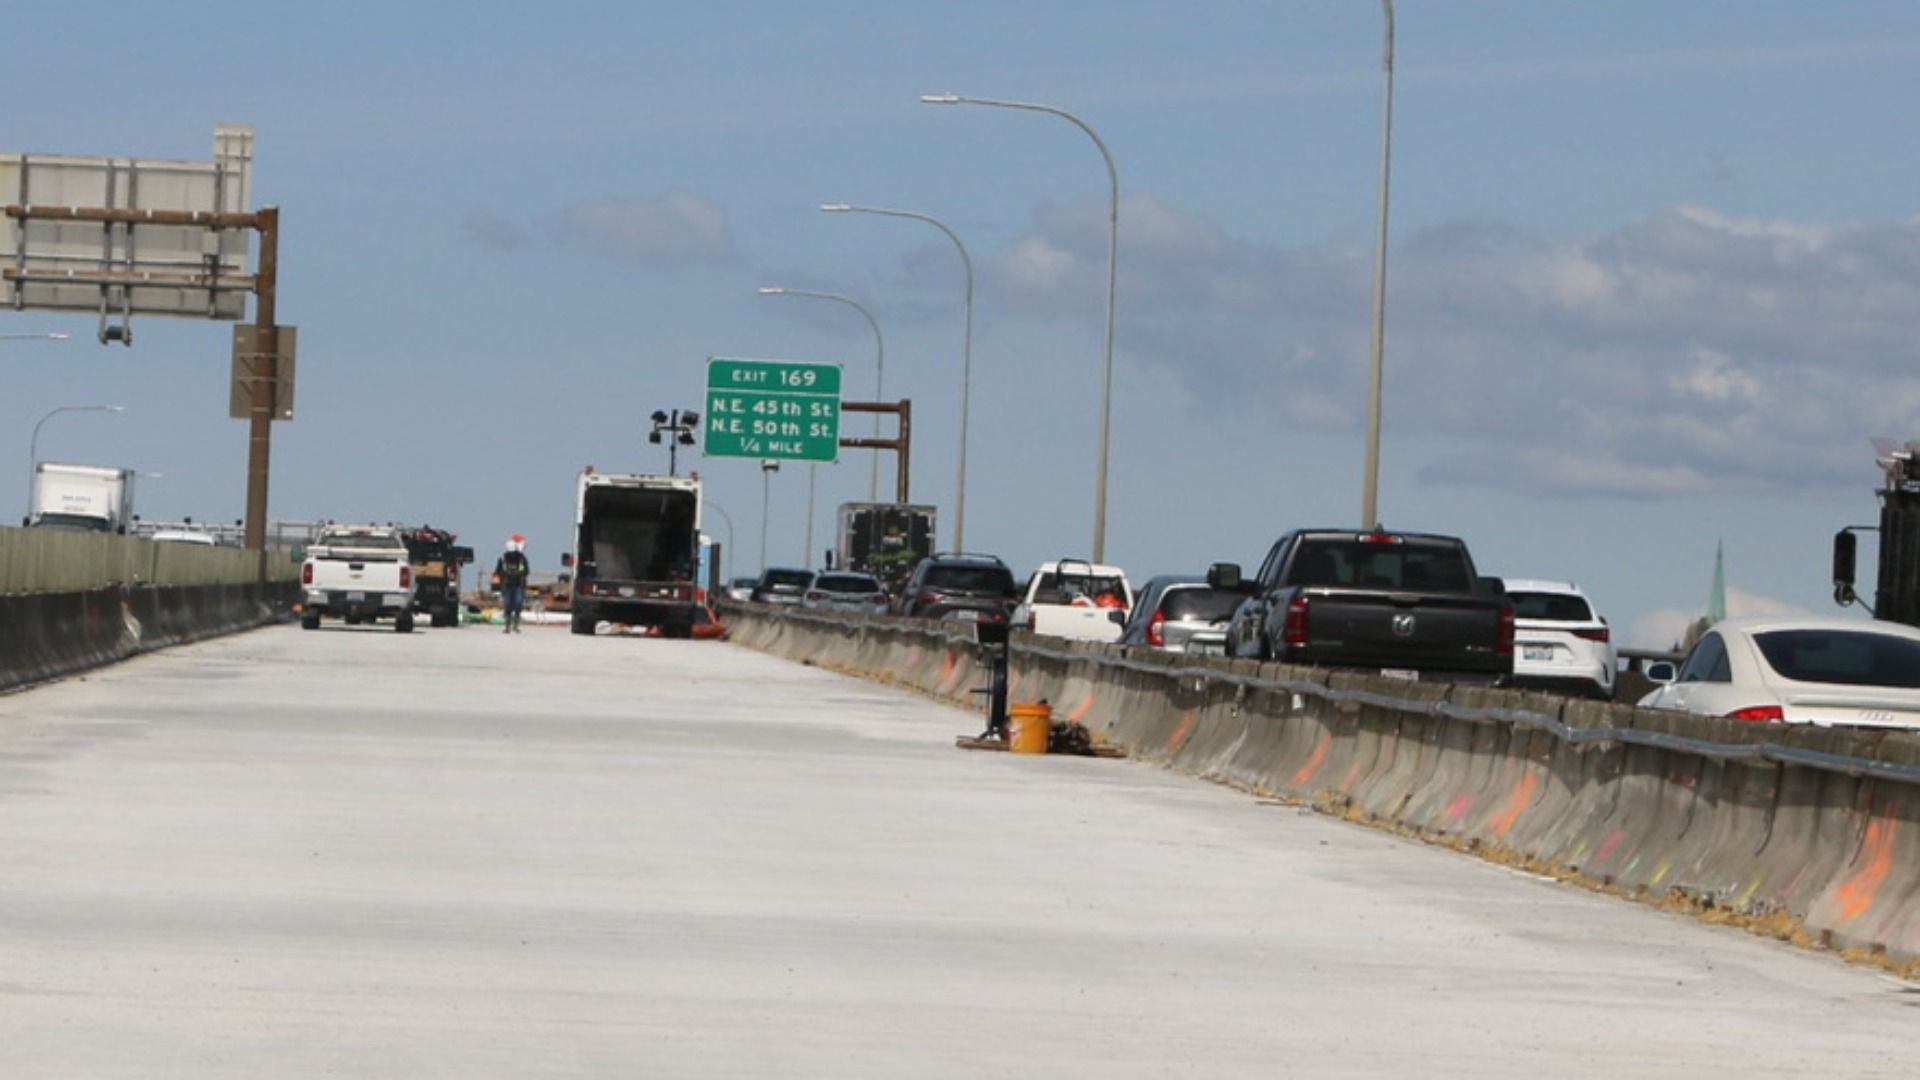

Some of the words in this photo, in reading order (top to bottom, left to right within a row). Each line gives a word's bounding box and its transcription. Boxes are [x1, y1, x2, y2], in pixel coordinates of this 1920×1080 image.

[731, 369, 767, 383] EXIT
[779, 369, 817, 387] 169
[752, 399, 801, 417] 45th
[753, 420, 800, 436] 50th
[809, 422, 833, 438] St.
[768, 441, 804, 454] MILE
